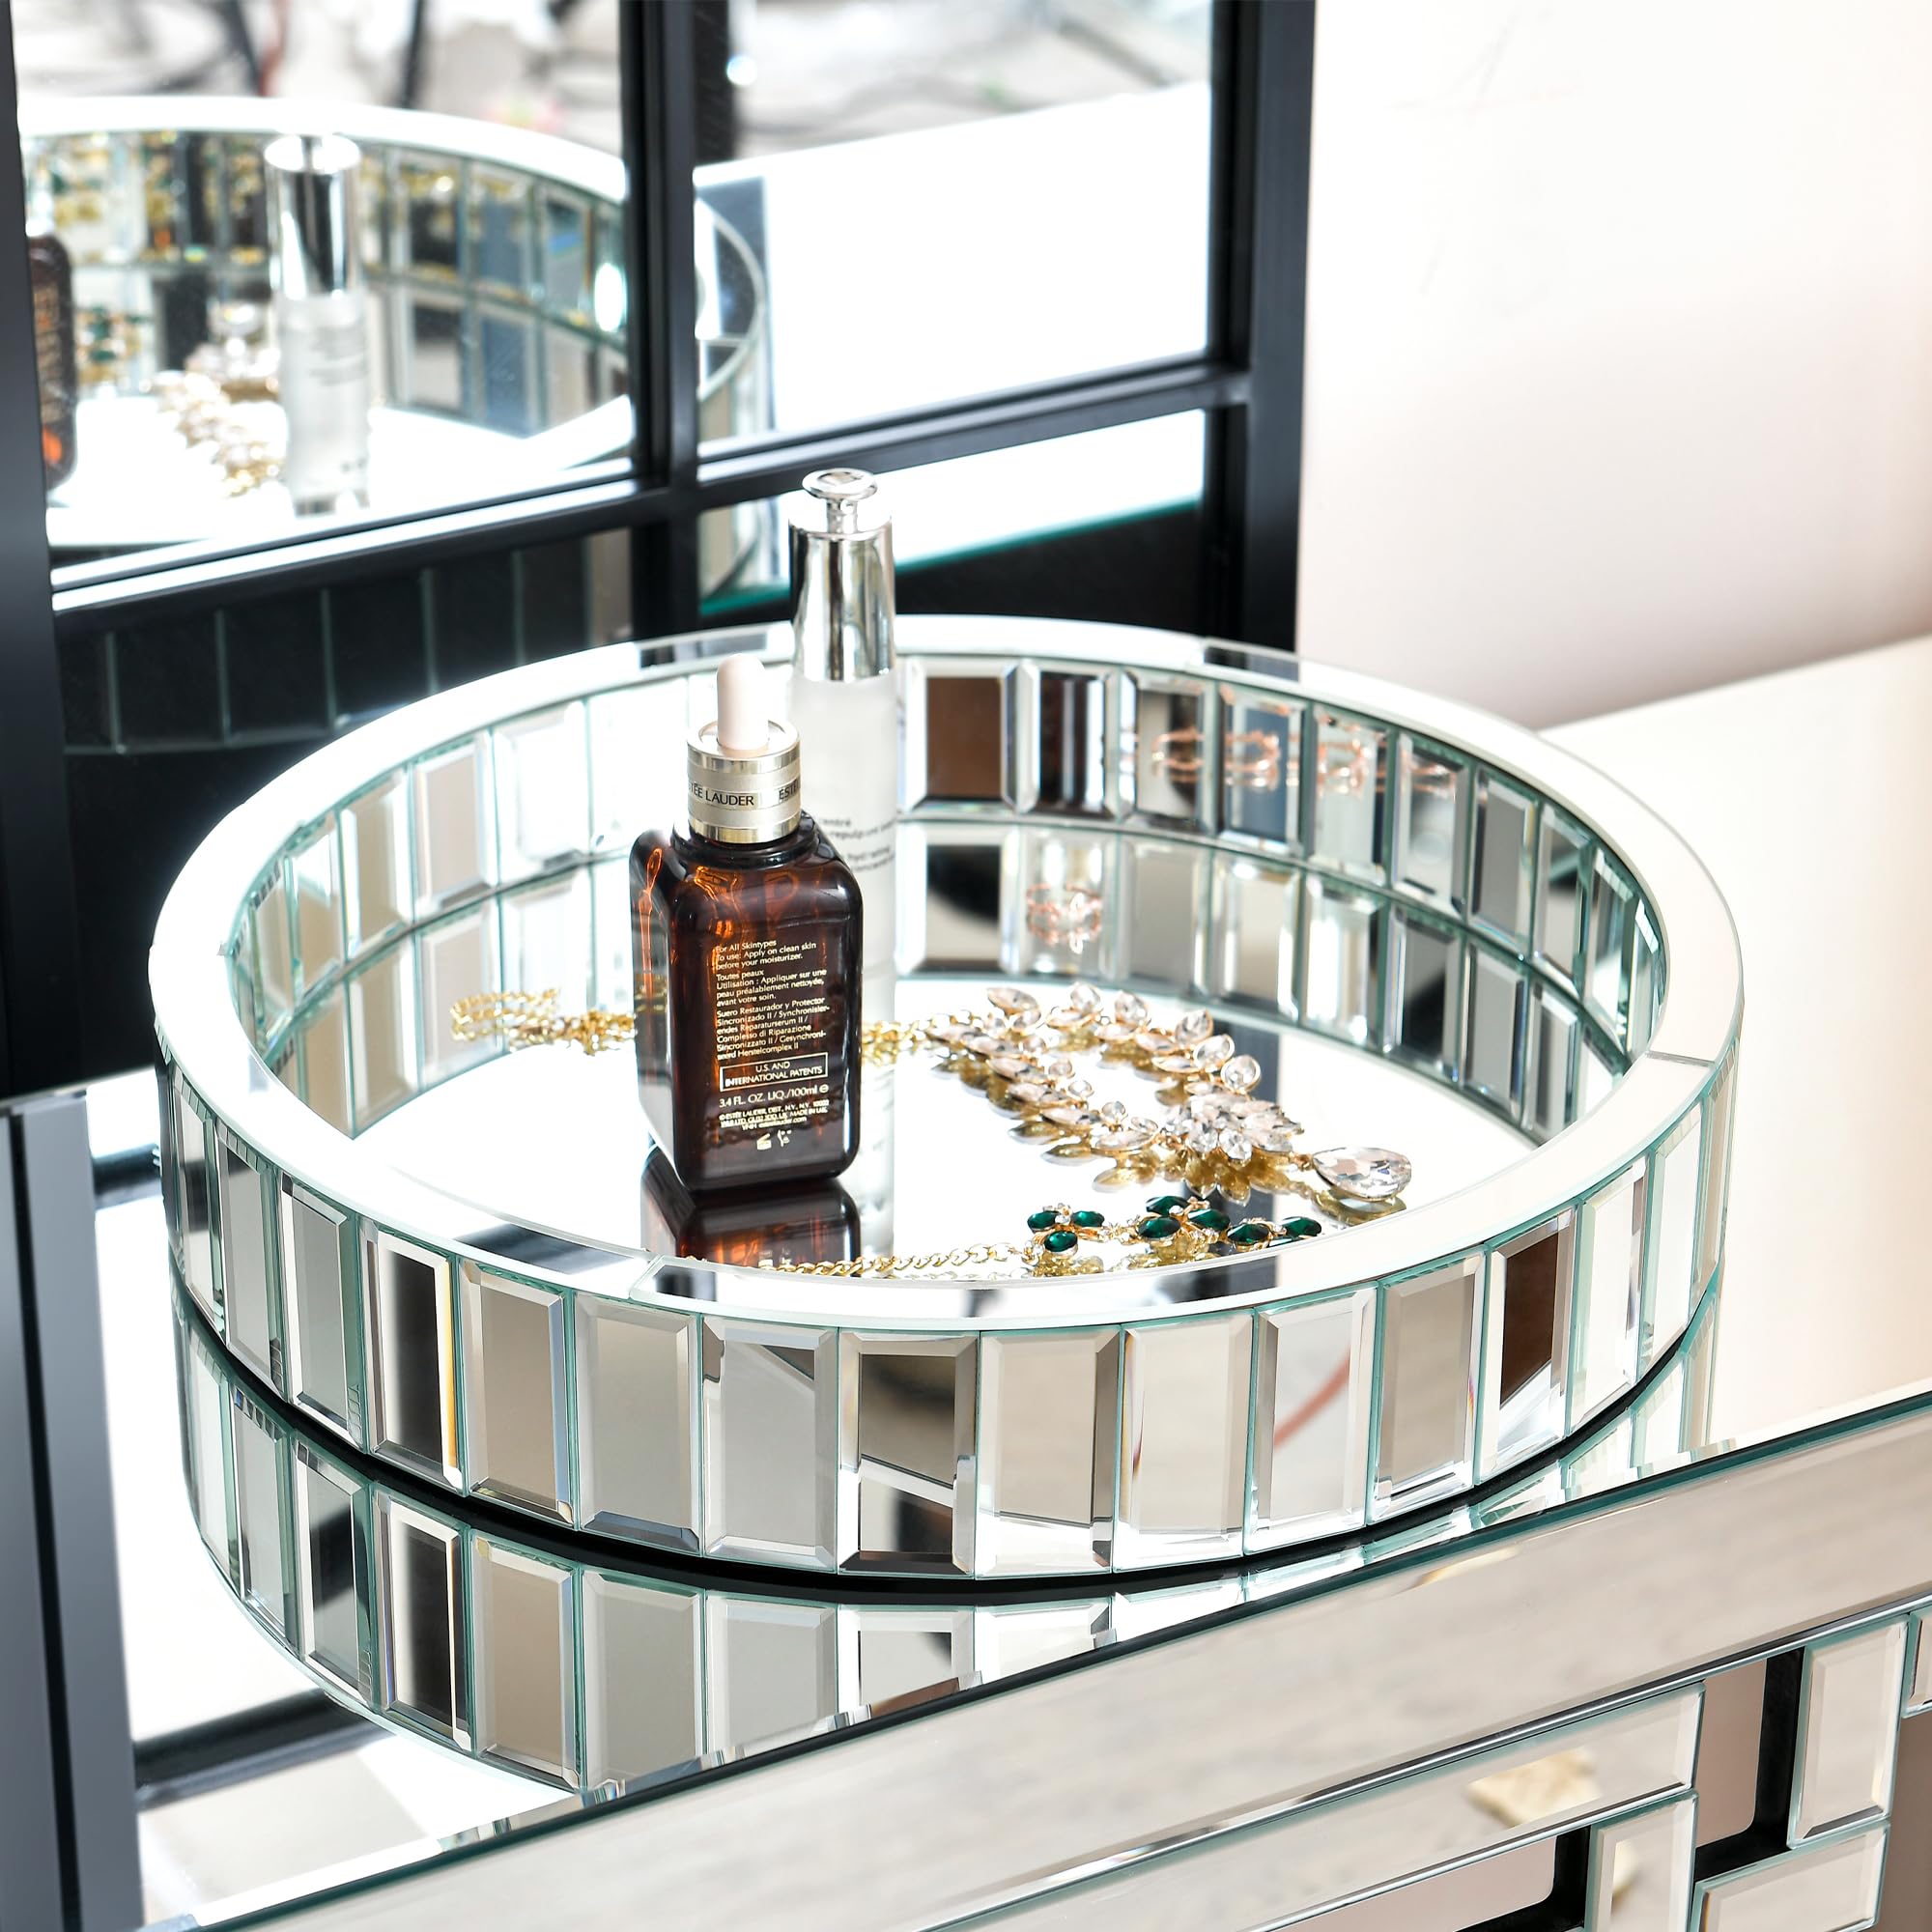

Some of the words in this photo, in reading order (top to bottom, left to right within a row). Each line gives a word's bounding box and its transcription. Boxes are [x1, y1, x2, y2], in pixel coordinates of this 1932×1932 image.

[705, 790, 754, 806] LAUDER
[742, 939, 777, 951] Skintypes
[743, 948, 766, 959] Apply
[779, 944, 800, 954] clean
[801, 941, 816, 951] skin
[716, 961, 740, 971] before
[741, 959, 758, 969] your
[759, 952, 804, 965] moisturizer.
[716, 979, 754, 990] Utilisation
[760, 973, 798, 984] Appliquer
[799, 971, 811, 980] sur
[717, 973, 740, 982] Toutes
[742, 969, 764, 979] peaux
[717, 990, 734, 1001] peau
[736, 981, 789, 997] préalablement
[717, 998, 737, 1008] avant
[738, 994, 757, 1004] votre
[758, 992, 777, 1002] soin.
[717, 1009, 738, 1019] Suero
[739, 1002, 782, 1015] Restaurador
[792, 997, 825, 1008] Protector
[717, 1014, 765, 1028] Sincronizado
[717, 1025, 738, 1036] endes
[740, 1018, 796, 1034] Reparaturserum
[717, 1033, 757, 1044] Complesso
[759, 1029, 767, 1037] di
[768, 1024, 811, 1037] Riparazione
[717, 1038, 767, 1053] Sincronizzato
[755, 1064, 770, 1072] U.S.
[772, 1061, 791, 1069] AND
[724, 1069, 788, 1087] INTERNATIONAL
[789, 1065, 823, 1075] PATENTS
[719, 1097, 731, 1108] 3.4
[748, 1092, 766, 1102] OZ.
